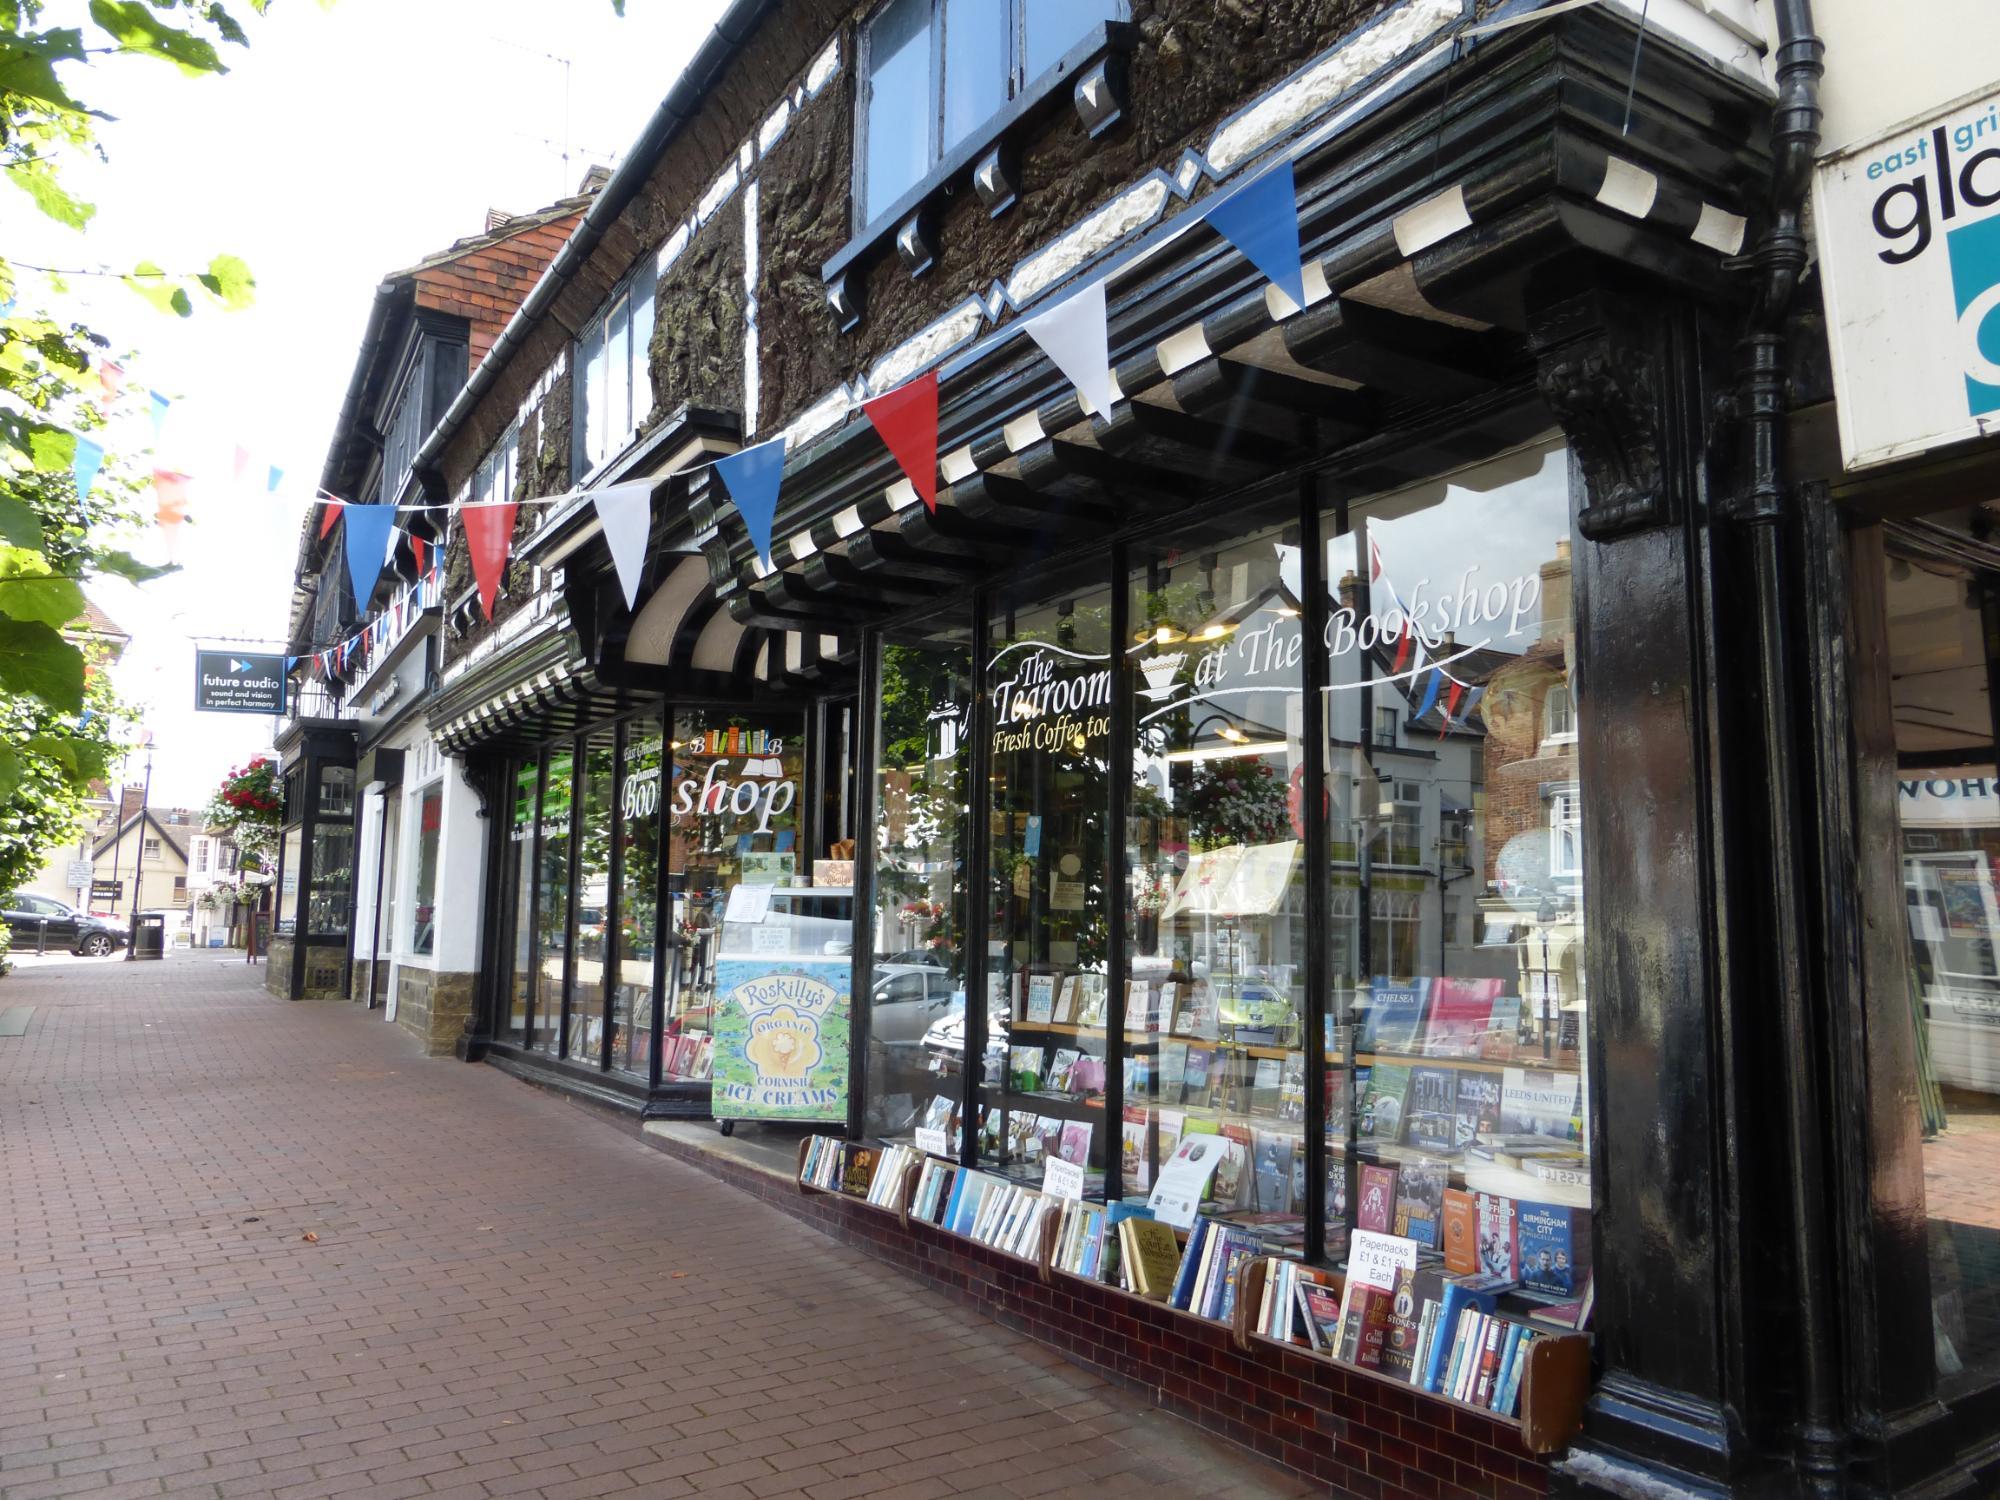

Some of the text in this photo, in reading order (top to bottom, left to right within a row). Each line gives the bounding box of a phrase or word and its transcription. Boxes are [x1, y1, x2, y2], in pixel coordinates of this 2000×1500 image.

[1866, 137, 1928, 181] east
[1194, 564, 1541, 687] at The Bookshop
[1018, 649, 1054, 688] The
[203, 673, 279, 689] future audio
[206, 698, 276, 709] in perfect harmony
[211, 690, 273, 700] sound and vision
[992, 669, 1111, 726] Tearoom
[992, 721, 1031, 754] Fresh
[1034, 713, 1083, 754] Coffee
[621, 774, 657, 820] Boo
[670, 759, 795, 834] shop
[743, 978, 826, 1008] Roskilly's
[1376, 992, 1415, 1004] CHELSEA
[757, 1019, 811, 1034] ORGANIC
[757, 1076, 809, 1087] CORNISH
[727, 1083, 838, 1106] ICE CREAMS
[1505, 1088, 1532, 1101] LEEDS
[1534, 1091, 1571, 1105] UNITED
[1394, 1215, 1408, 1237] 30
[1523, 1214, 1567, 1229] BIRMINGHAM
[1536, 1224, 1553, 1235] CITY
[1360, 1236, 1409, 1257] Paperbacks
[1360, 1251, 1406, 1269] £1 & £1.50
[1369, 1268, 1392, 1283] Each
[1387, 1314, 1417, 1330] STONE'S
